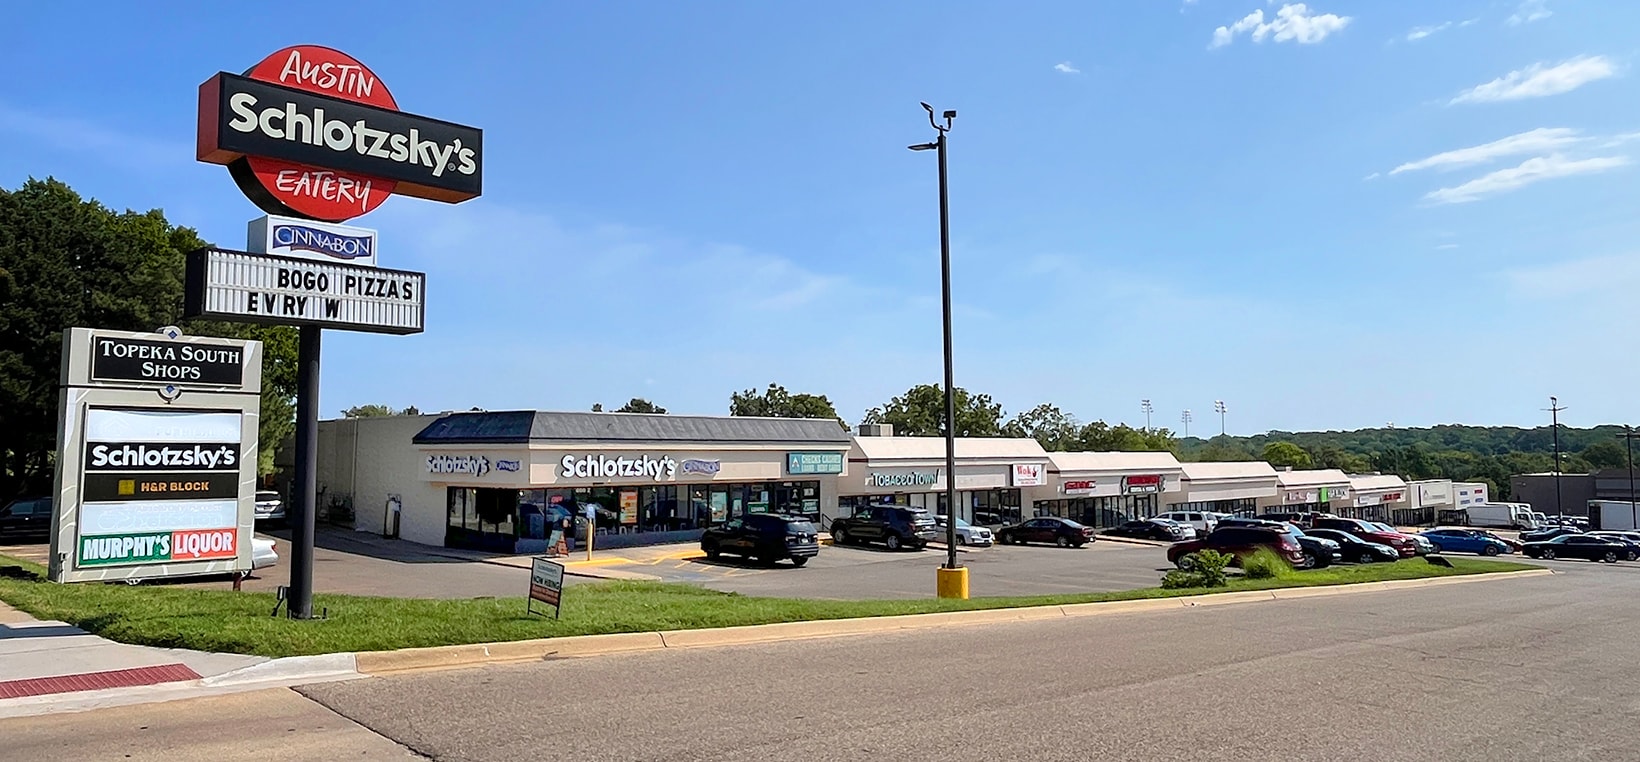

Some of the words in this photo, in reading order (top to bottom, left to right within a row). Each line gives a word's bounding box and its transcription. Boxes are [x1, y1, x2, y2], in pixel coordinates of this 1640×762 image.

[279, 50, 375, 98] AUSTIN
[228, 92, 477, 178] Schlotzsky's
[276, 169, 373, 212] EATERY
[274, 225, 372, 257] CINNABON
[277, 267, 329, 293] BOGO
[345, 275, 413, 300] PIZZAS
[325, 299, 340, 318] W
[99, 340, 176, 361] TOPEKA
[181, 346, 240, 364] SOUTH
[141, 361, 201, 380] SHOPS
[91, 445, 235, 469] Schlotzsky's
[561, 454, 676, 481] Schlotzsky's
[141, 481, 167, 492] H&R
[170, 481, 210, 492] BLOCK
[872, 472, 914, 487] TOBACCO
[914, 471, 936, 485] TOWN
[82, 534, 170, 561] MURPHY'S
[173, 531, 234, 556] LIQUOR
